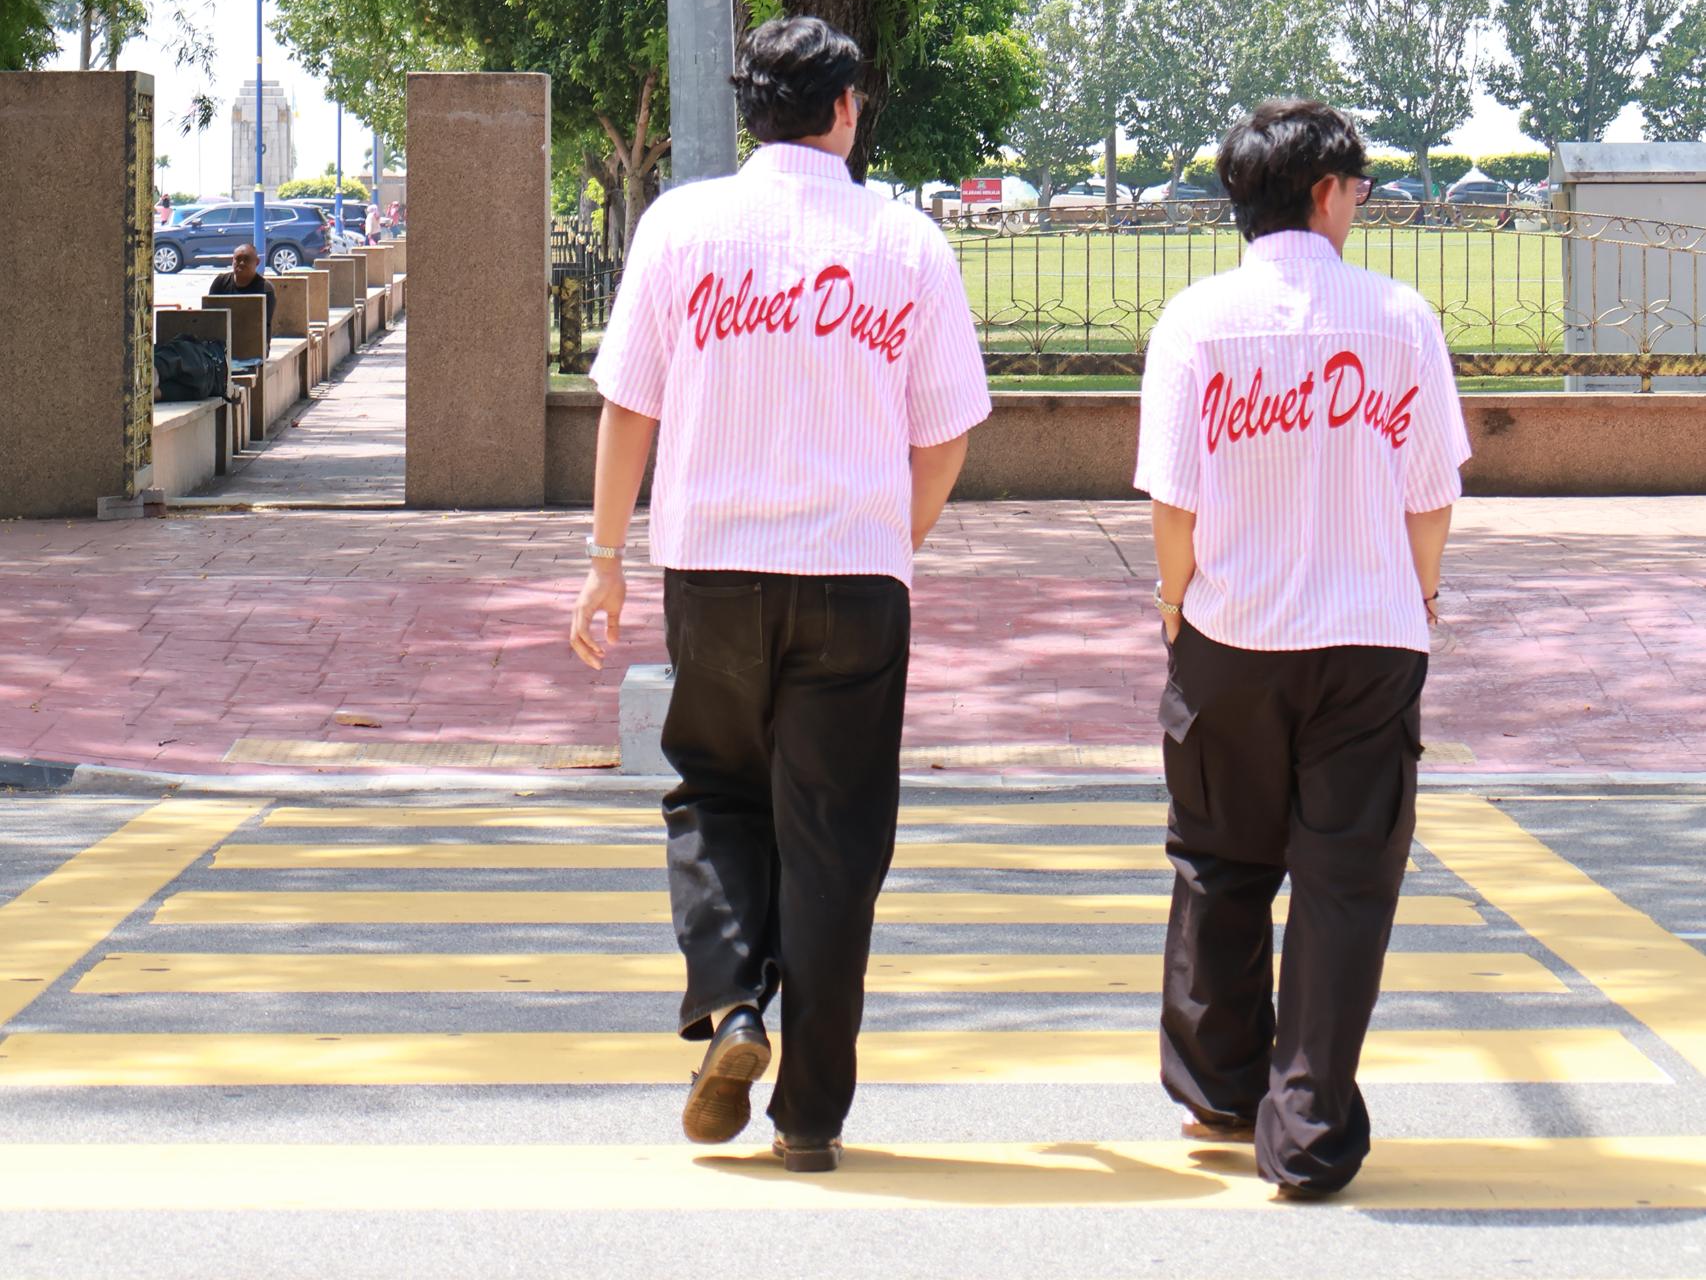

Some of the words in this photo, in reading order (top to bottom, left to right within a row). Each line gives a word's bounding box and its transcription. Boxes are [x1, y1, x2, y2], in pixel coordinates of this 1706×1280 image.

[688, 268, 804, 351] Velvet
[814, 264, 914, 363] Dusk
[1202, 366, 1315, 454] Velvet
